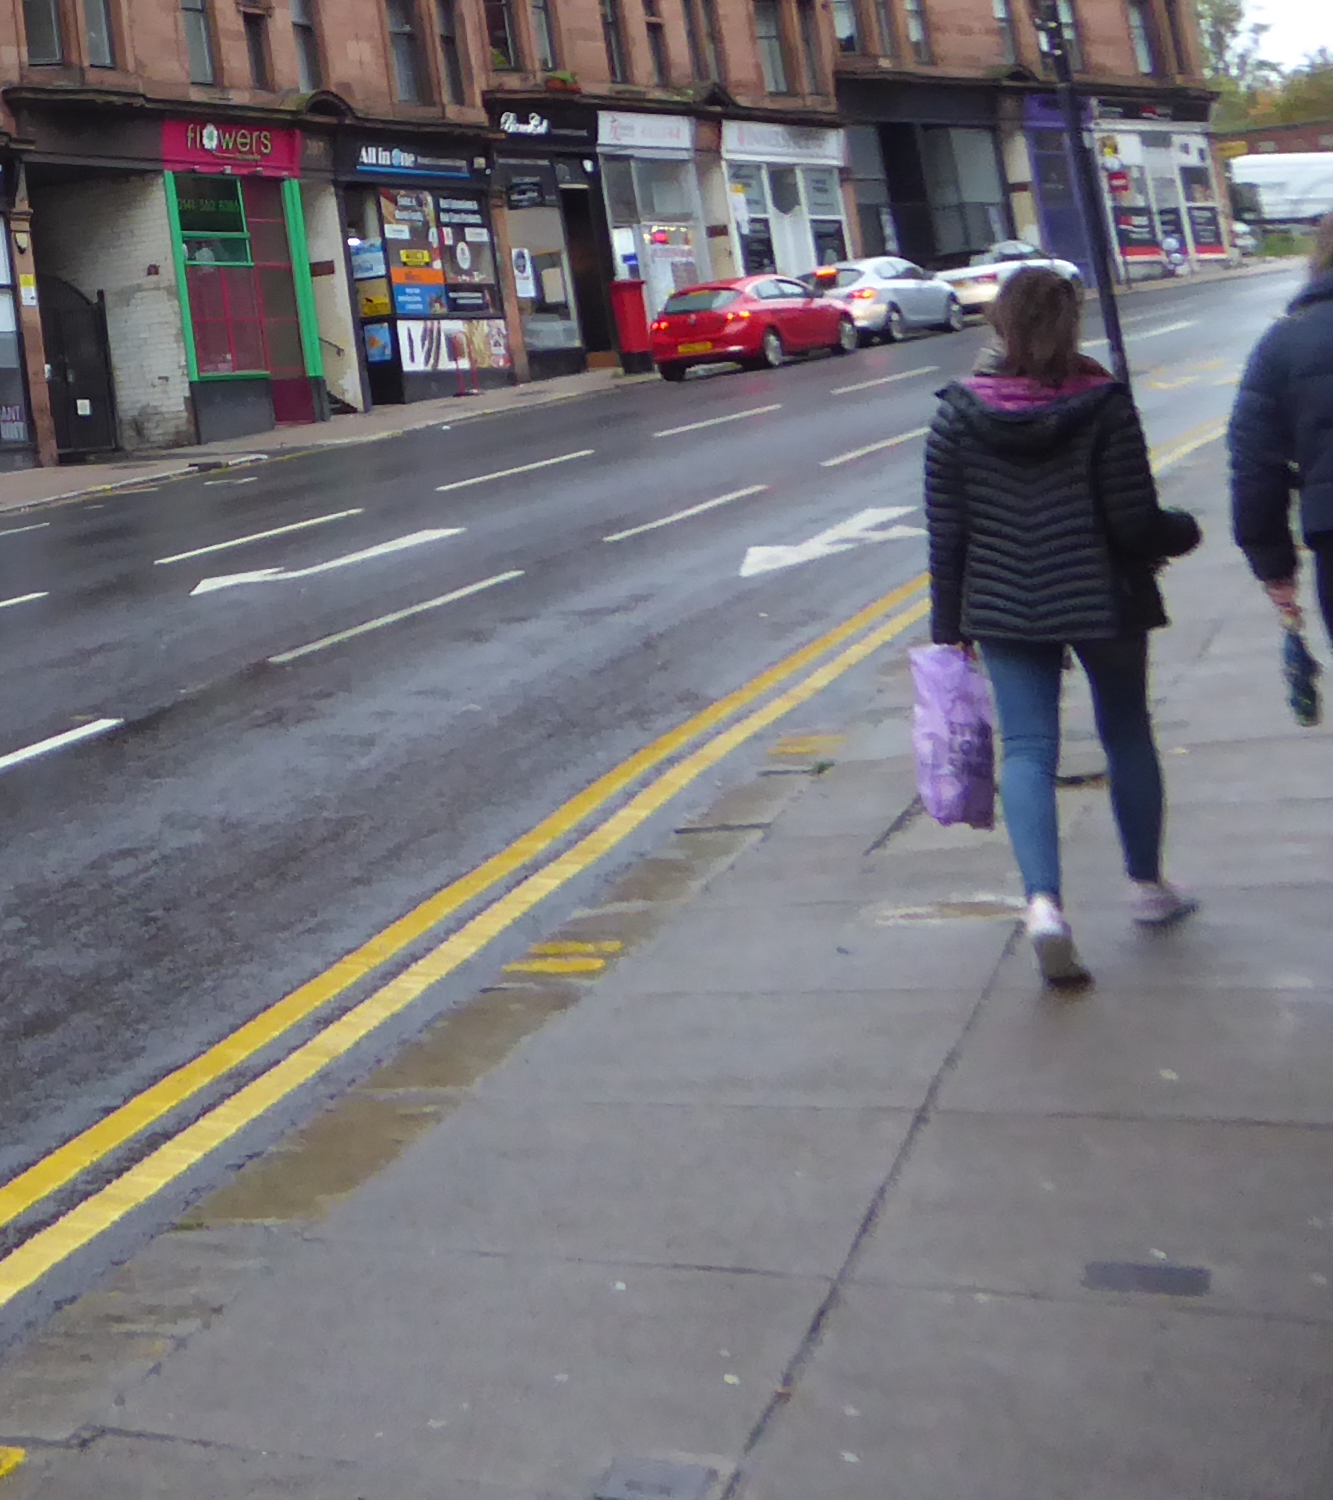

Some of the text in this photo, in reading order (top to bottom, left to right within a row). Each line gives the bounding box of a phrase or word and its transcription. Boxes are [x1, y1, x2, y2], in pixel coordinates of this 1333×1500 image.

[186, 122, 272, 154] flowers
[359, 145, 377, 164] All
[378, 146, 391, 165] in
[391, 148, 415, 167] One
